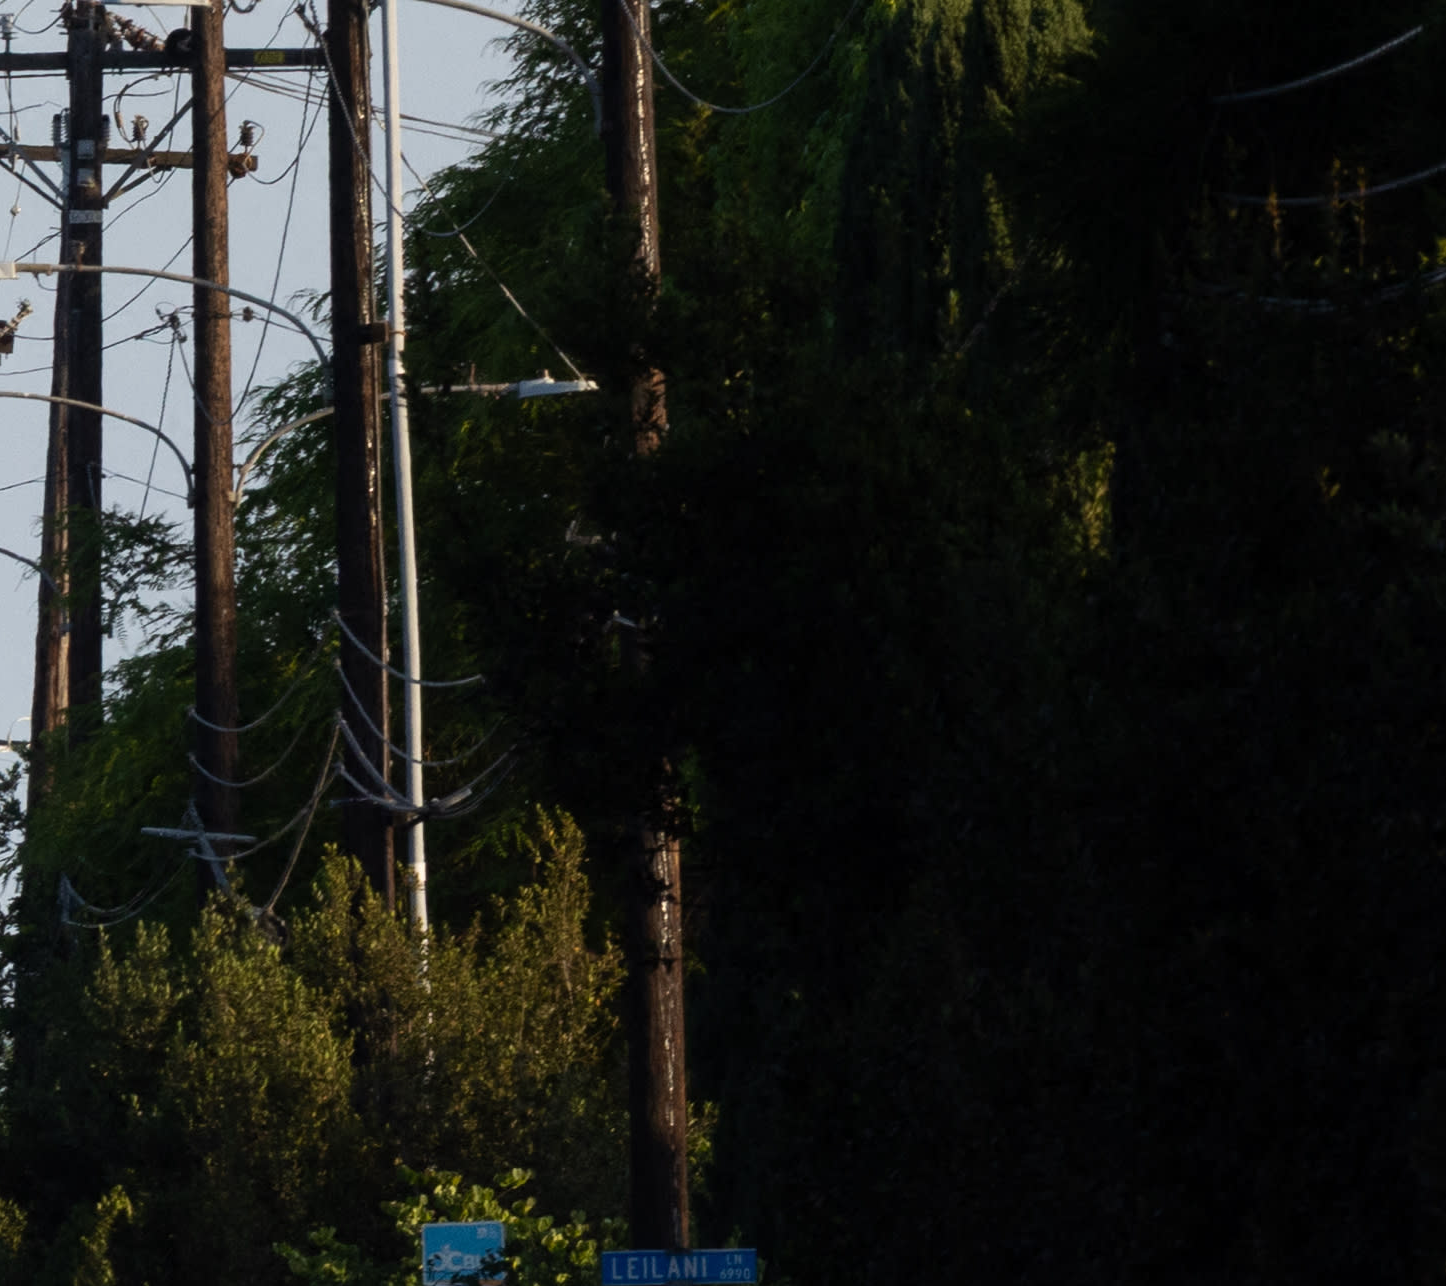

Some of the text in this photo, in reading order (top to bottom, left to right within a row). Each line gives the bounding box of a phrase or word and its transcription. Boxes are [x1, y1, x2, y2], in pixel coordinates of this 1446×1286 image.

[611, 1254, 743, 1280] LEILANI LN
[719, 1268, 752, 1280] 6990
